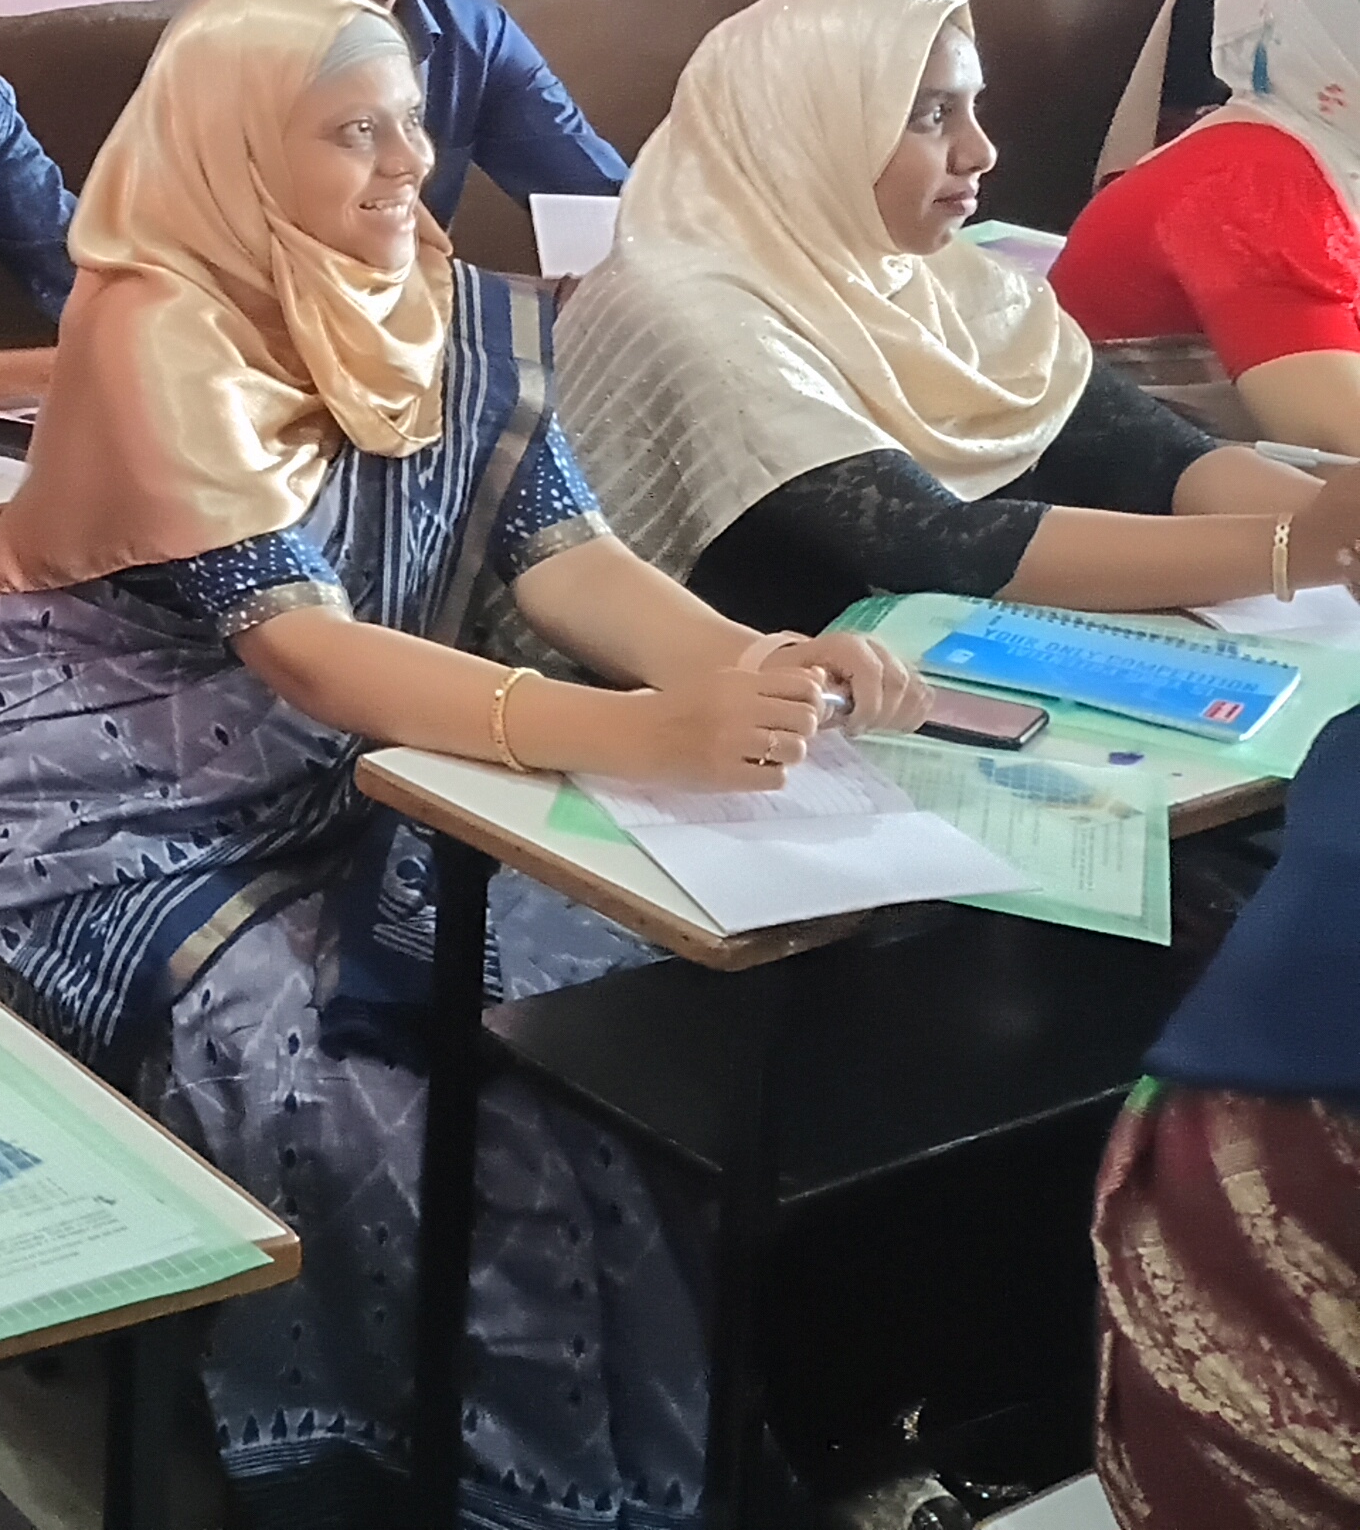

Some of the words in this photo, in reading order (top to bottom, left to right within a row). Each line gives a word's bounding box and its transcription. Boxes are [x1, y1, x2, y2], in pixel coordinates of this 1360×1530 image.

[983, 628, 1041, 647] YOUR
[1044, 640, 1103, 659] ONLY
[1105, 653, 1262, 691] COMPETITION
